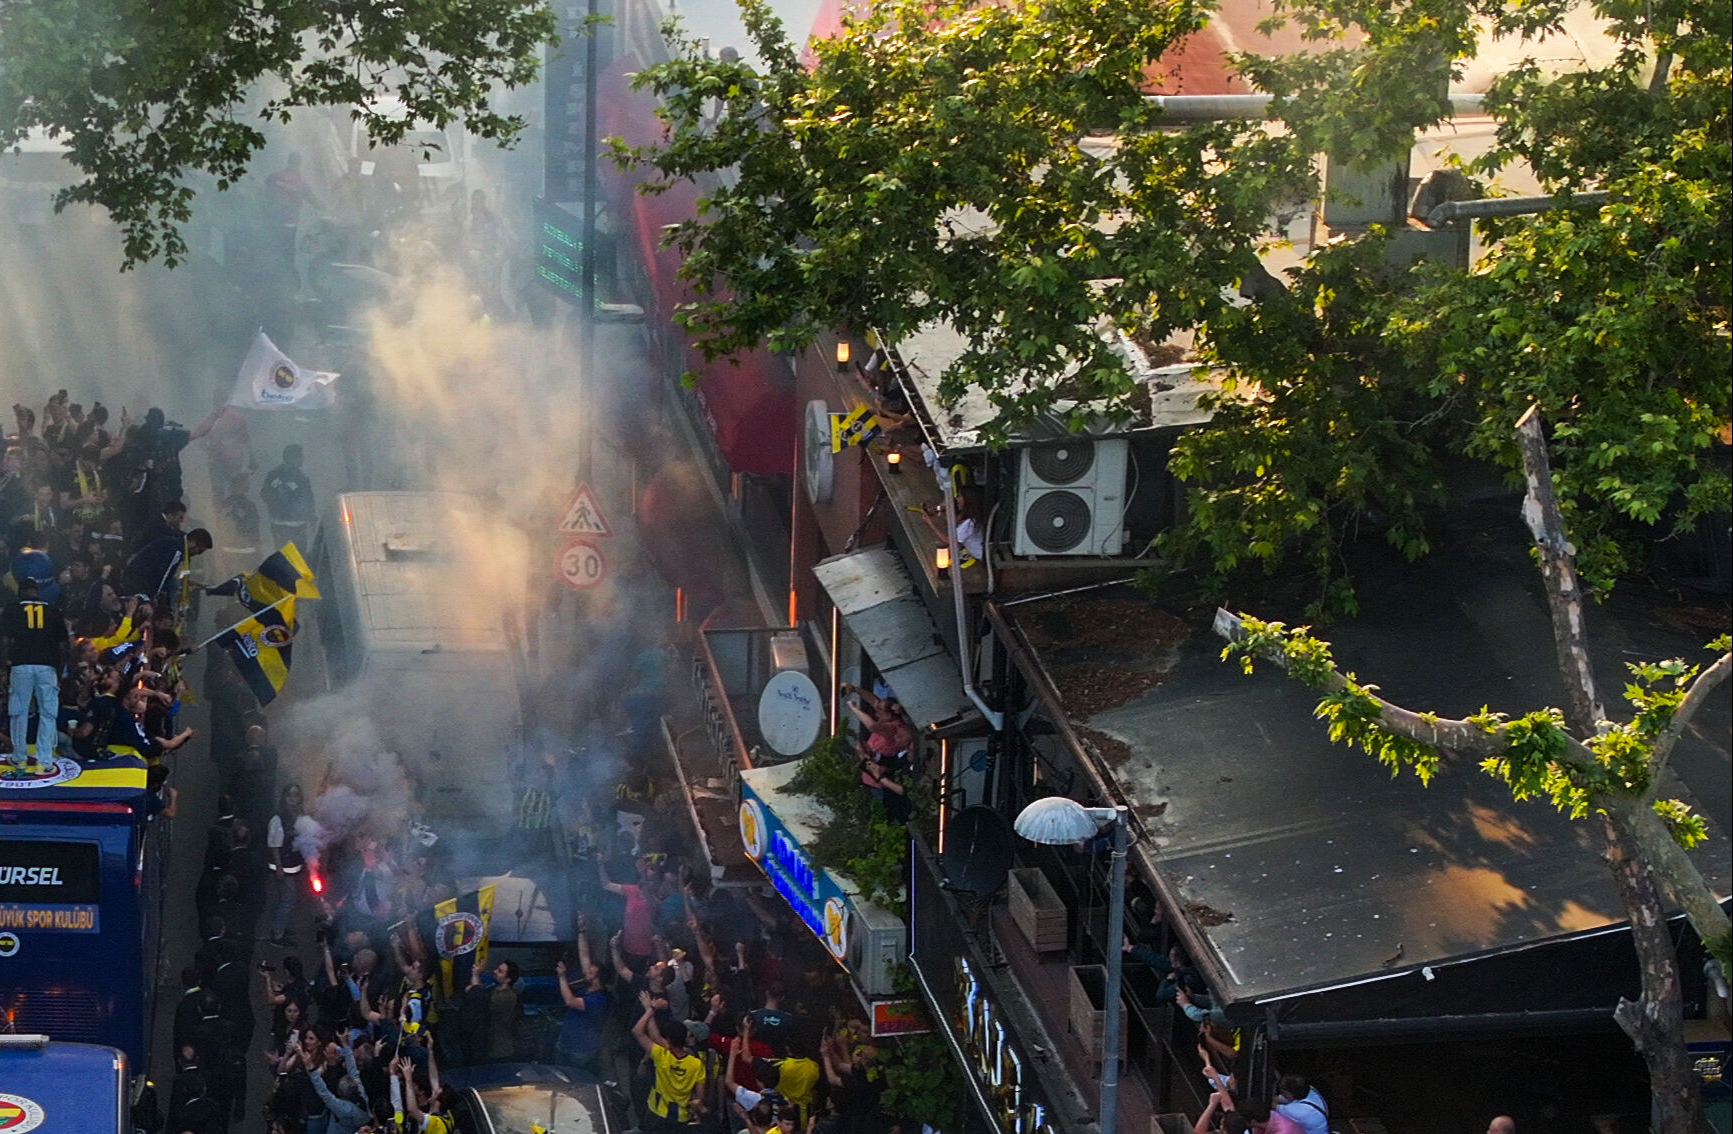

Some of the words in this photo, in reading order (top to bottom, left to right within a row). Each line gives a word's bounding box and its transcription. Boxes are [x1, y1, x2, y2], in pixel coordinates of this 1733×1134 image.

[561, 554, 598, 578] 30
[24, 604, 44, 629] 11
[27, 911, 53, 928] SPOR
[55, 907, 94, 929] KULÜBÜ
